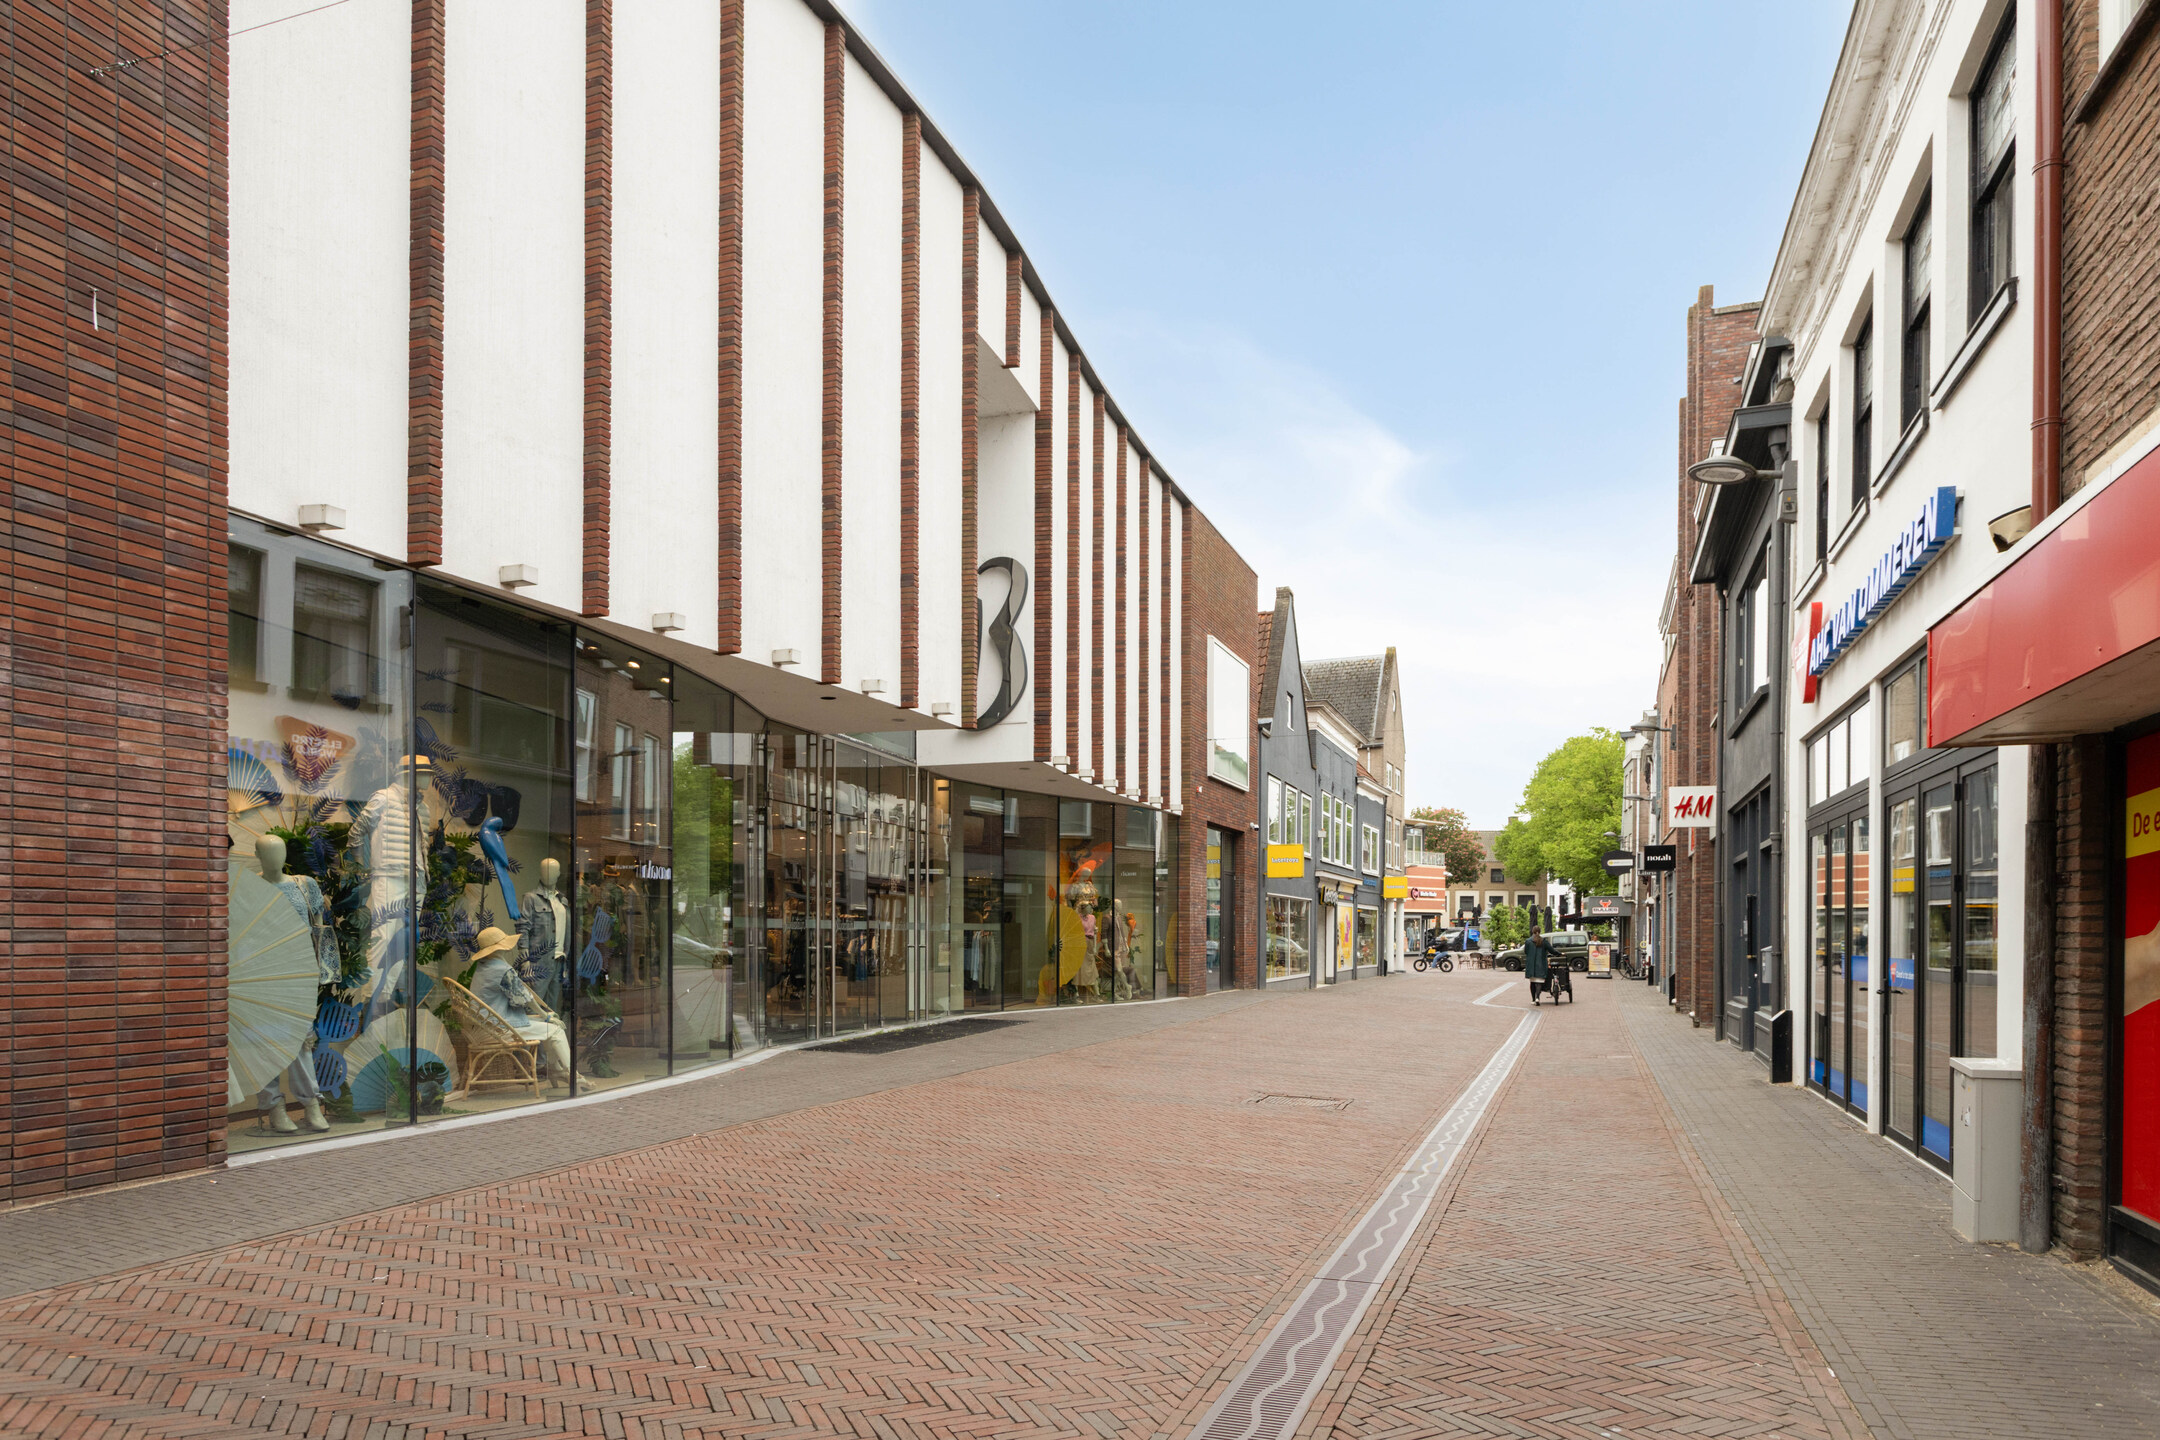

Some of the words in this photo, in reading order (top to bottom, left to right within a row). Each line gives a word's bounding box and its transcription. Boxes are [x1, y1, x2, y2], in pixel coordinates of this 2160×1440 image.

[1809, 621, 1830, 675] AHC
[1833, 593, 1856, 649] VAN
[1858, 487, 1938, 621] OMMEREN
[1674, 795, 1714, 818] H&M
[2133, 812, 2150, 838] De
